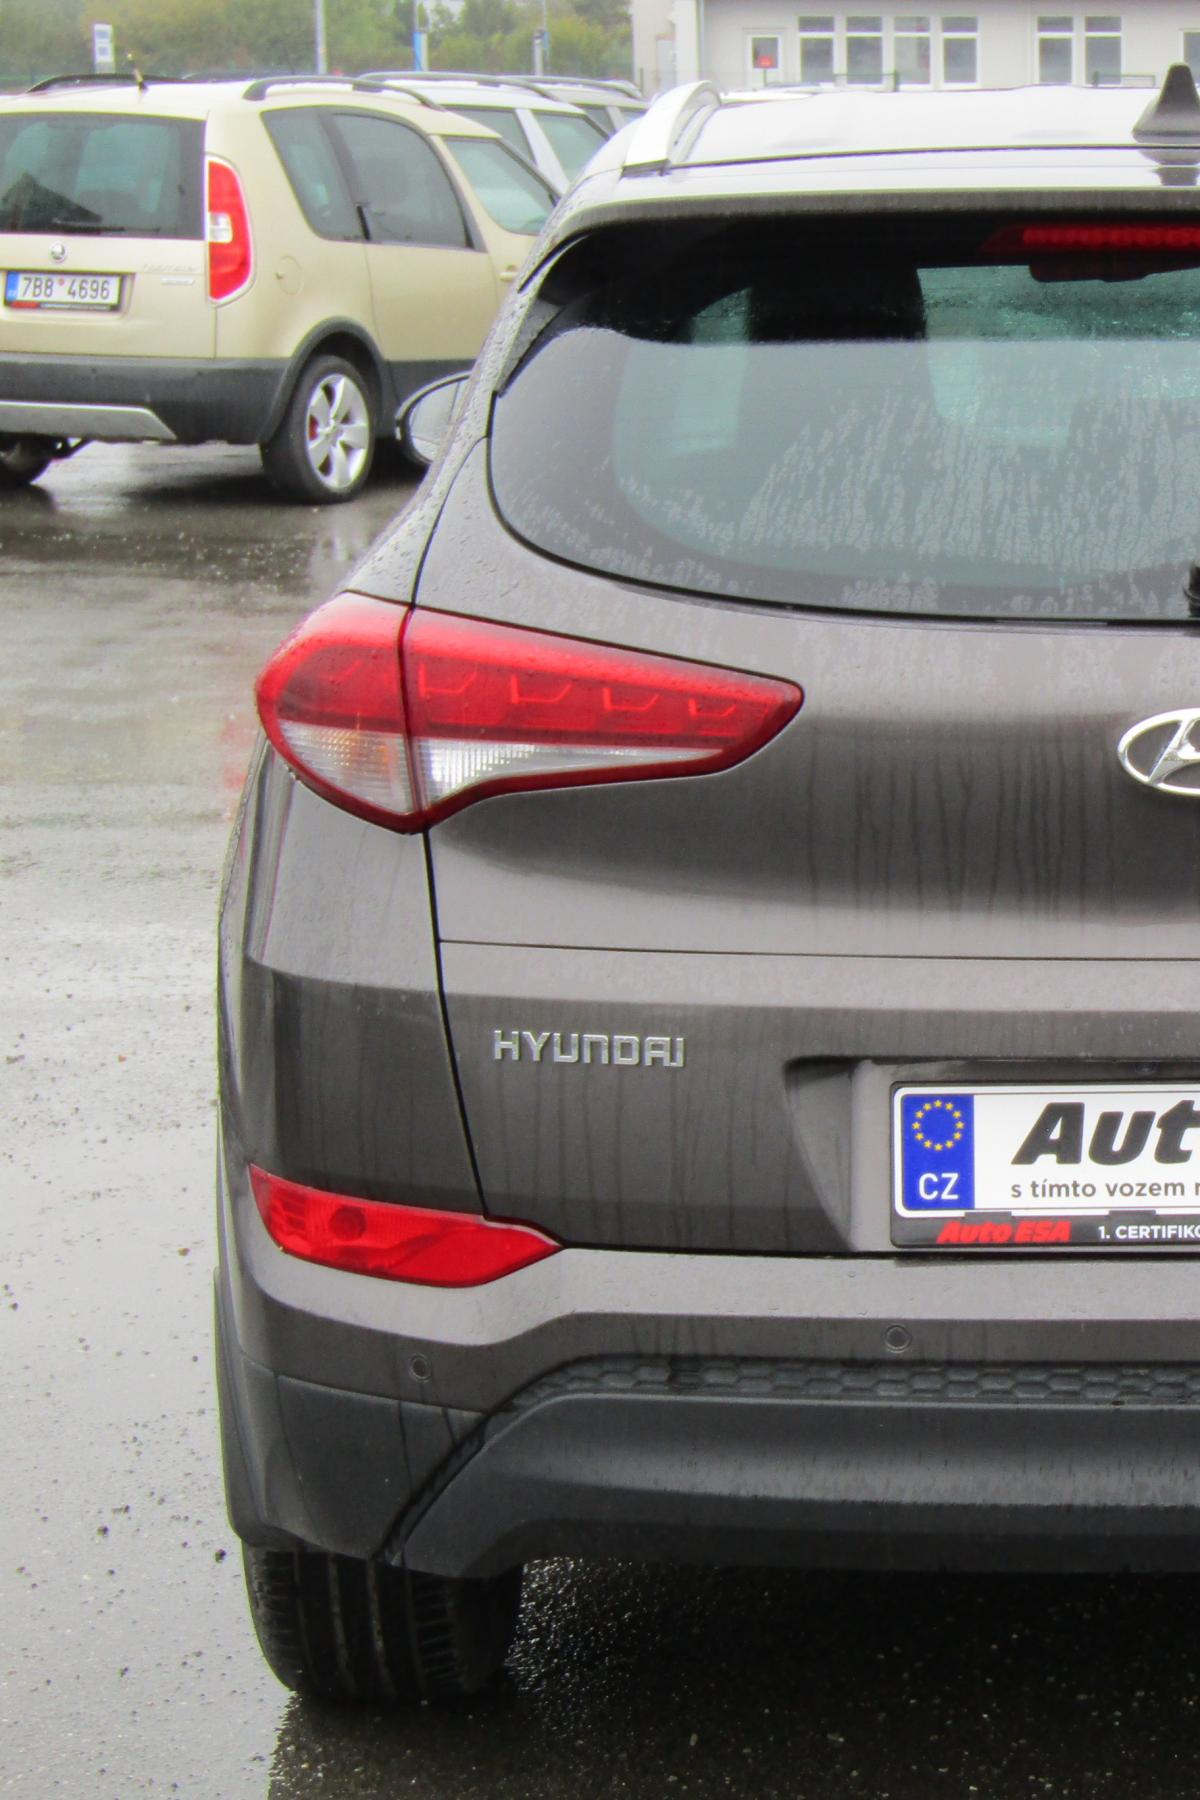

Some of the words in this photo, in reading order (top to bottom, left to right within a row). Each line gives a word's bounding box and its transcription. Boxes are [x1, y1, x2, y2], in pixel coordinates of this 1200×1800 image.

[22, 276, 54, 297] 7B8
[67, 278, 111, 299] 4696
[493, 1029, 685, 1067] HYUNDAI
[917, 1172, 959, 1201] CZ
[1010, 1184, 1022, 1199] s
[1029, 1178, 1097, 1199] tímto
[1105, 1181, 1185, 1198] vozem
[936, 1220, 1012, 1244] Auto
[1014, 1220, 1072, 1243] ESA
